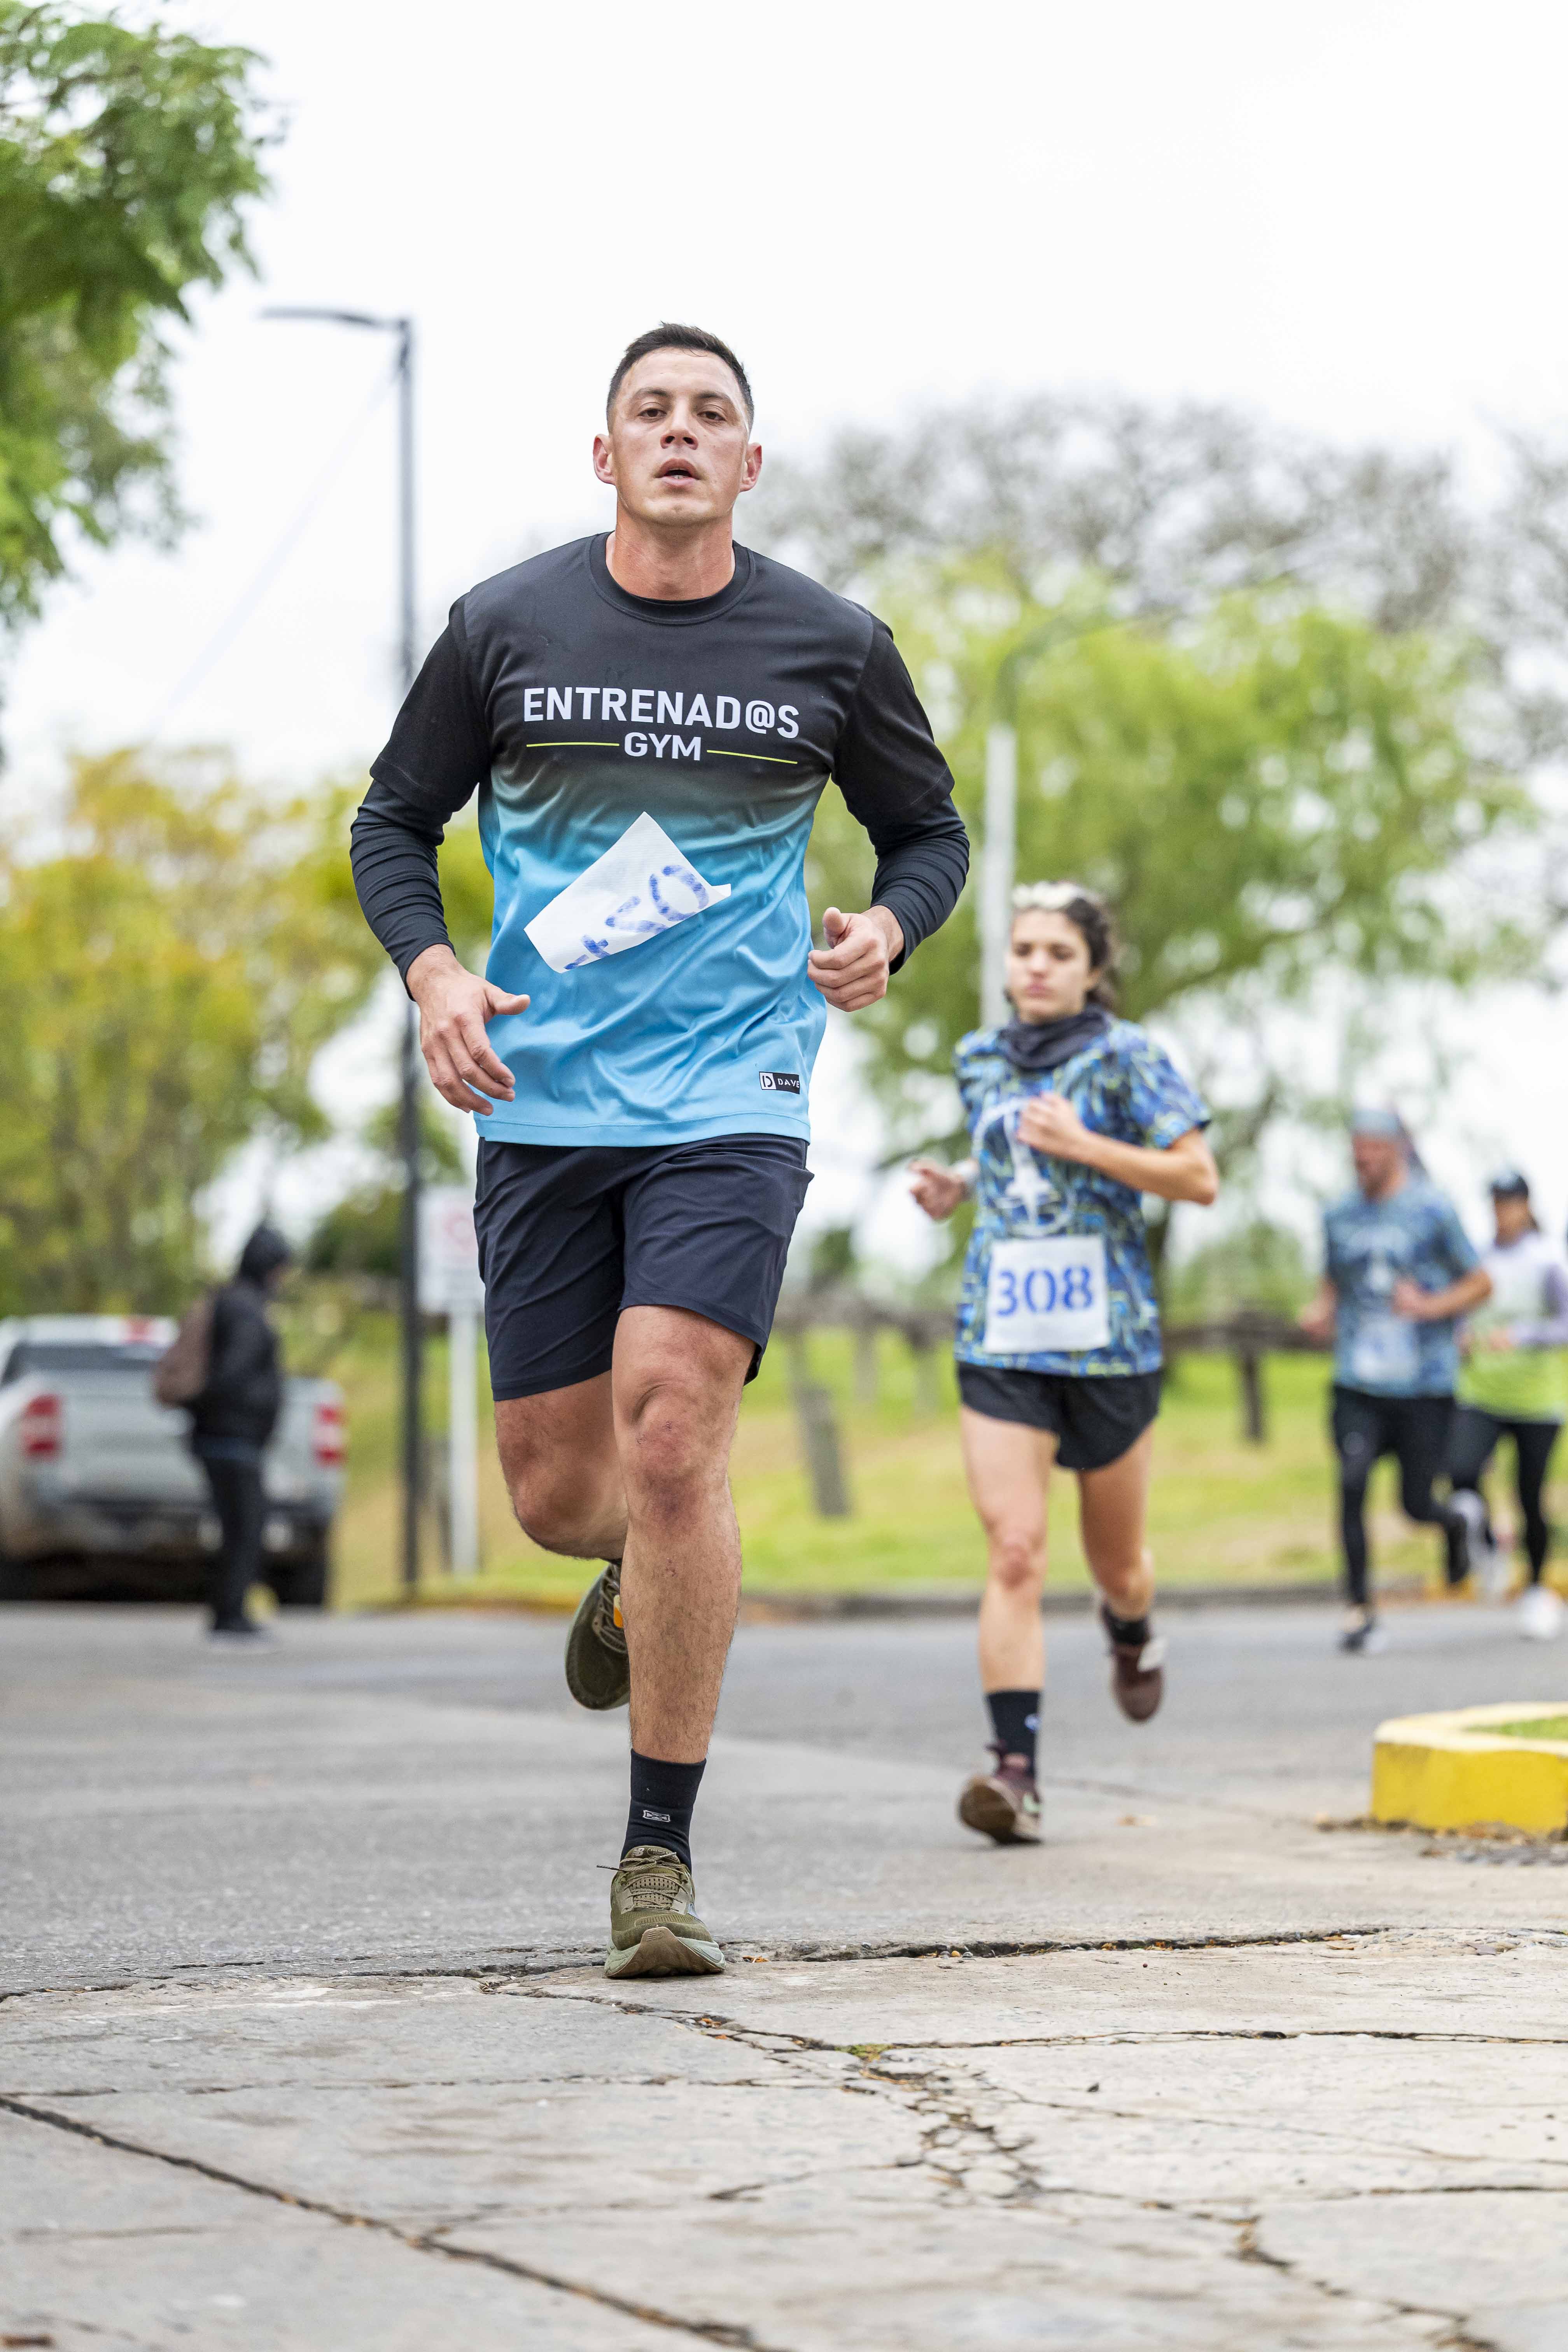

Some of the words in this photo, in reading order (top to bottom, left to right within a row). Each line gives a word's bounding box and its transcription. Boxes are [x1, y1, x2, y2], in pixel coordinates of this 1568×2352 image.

[523, 687, 799, 739] ENTRENAD@S
[624, 732, 701, 761] GYM
[996, 1266, 1094, 1317] 308
